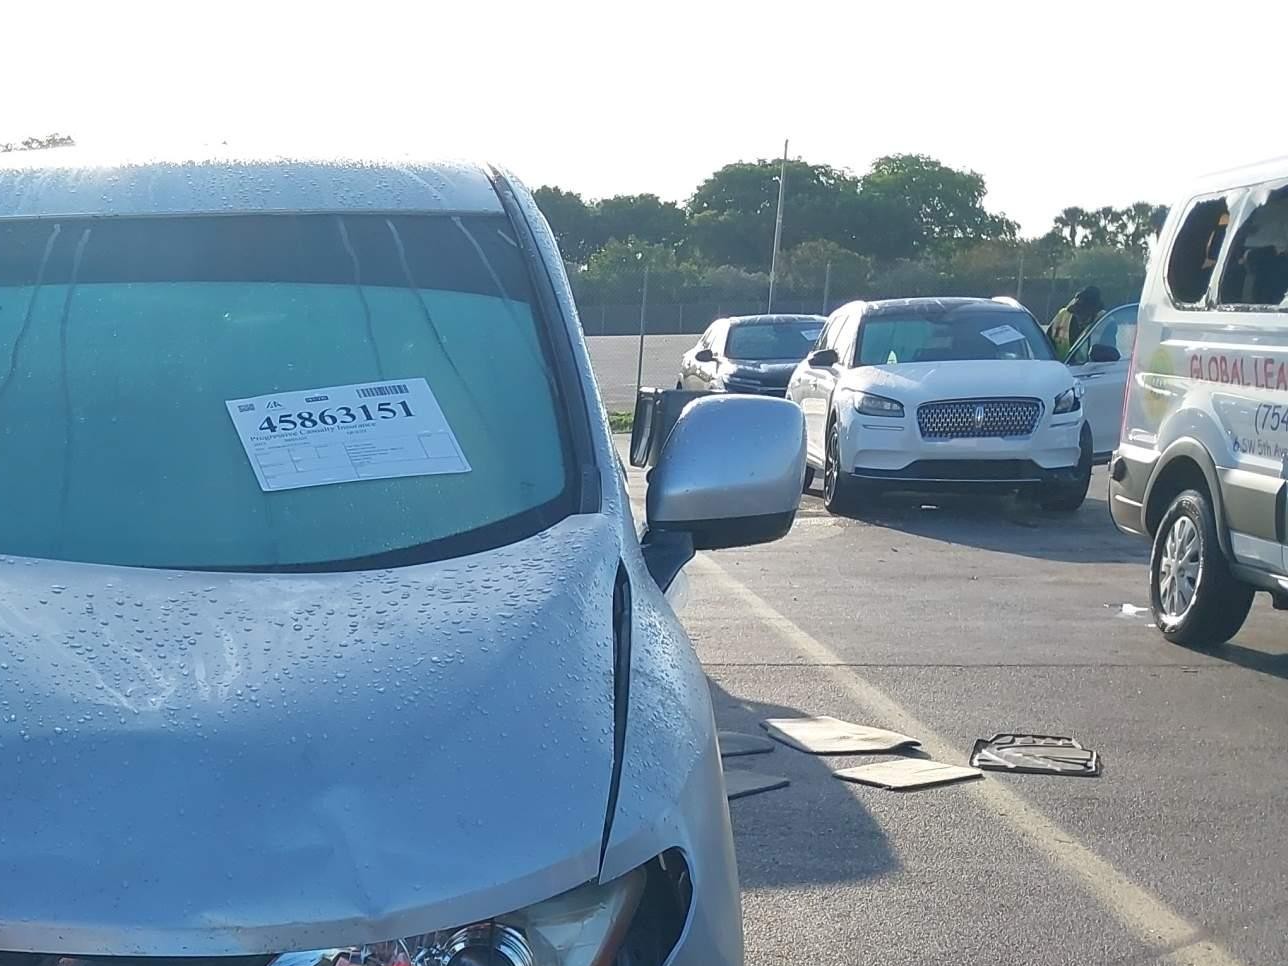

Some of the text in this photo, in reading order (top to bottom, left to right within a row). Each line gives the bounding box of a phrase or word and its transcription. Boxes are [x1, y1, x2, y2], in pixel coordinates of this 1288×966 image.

[1190, 354, 1251, 386] GLOBAL
[258, 400, 416, 433] 45863151
[1241, 438, 1255, 454] SW
[1258, 440, 1272, 457] 5th
